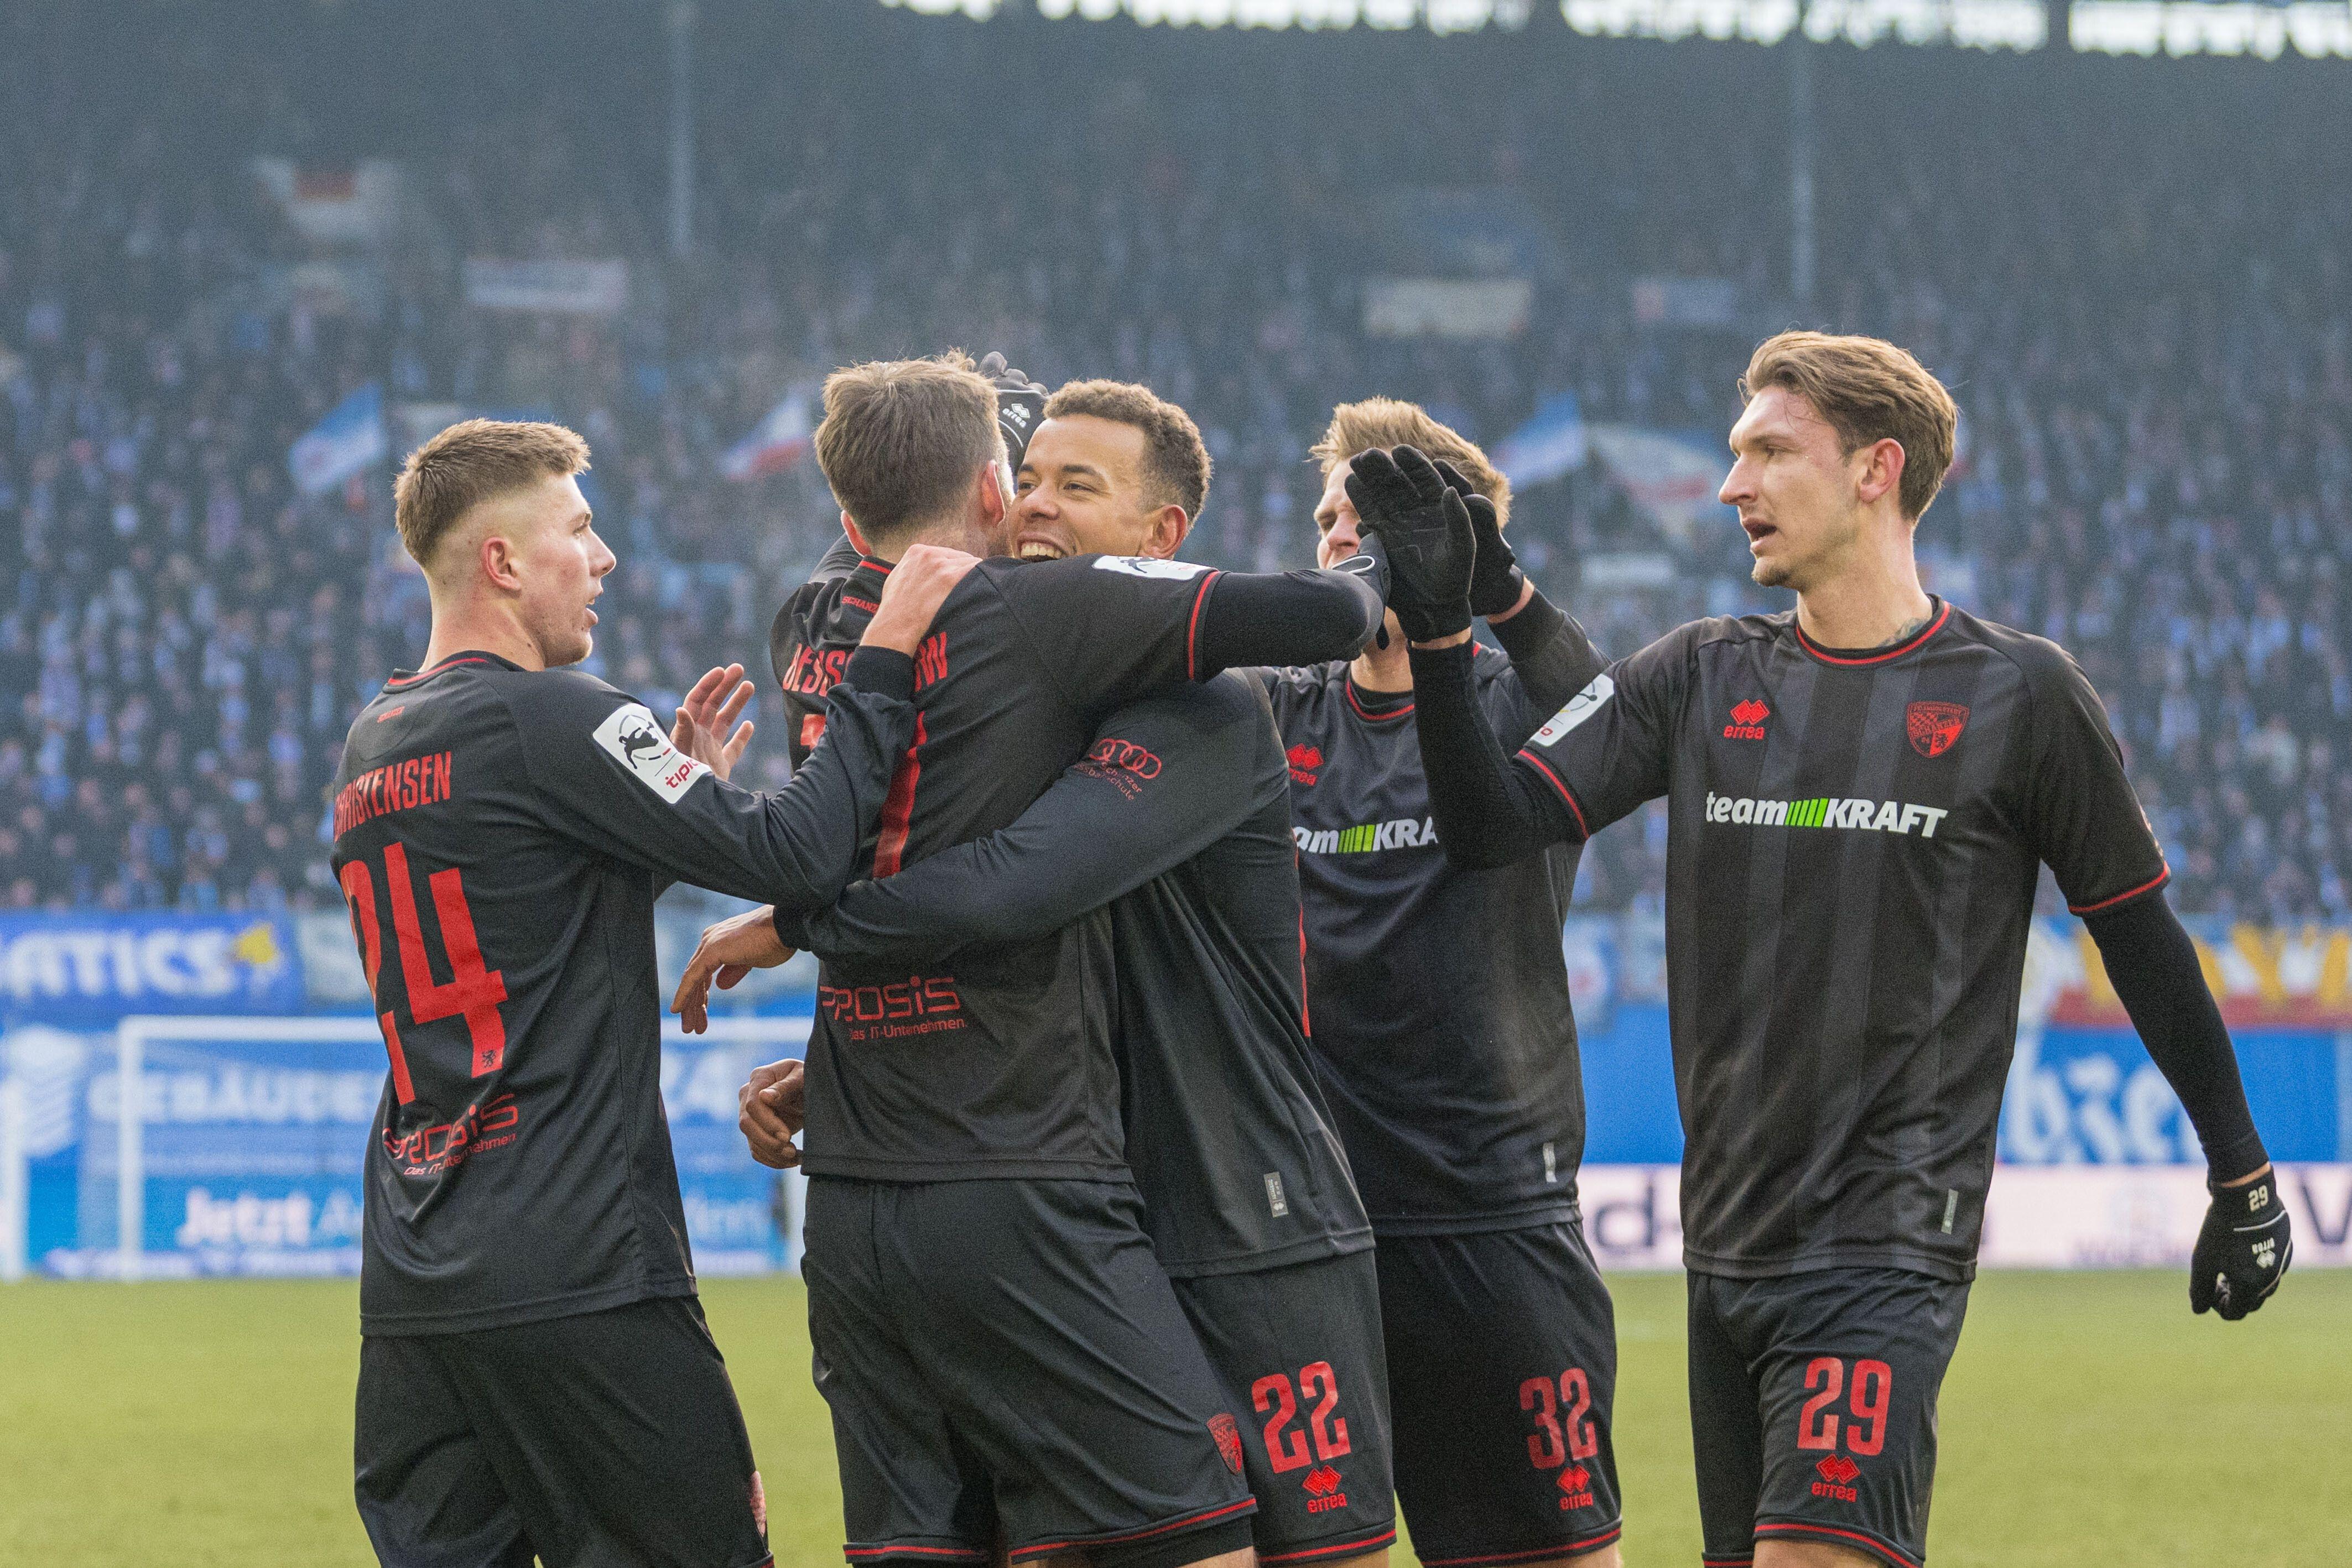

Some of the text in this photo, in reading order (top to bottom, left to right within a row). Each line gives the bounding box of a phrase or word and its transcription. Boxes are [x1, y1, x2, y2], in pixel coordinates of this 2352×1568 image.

[1002, 408, 1027, 428] errea
[1724, 725, 1765, 739] errea
[2248, 1185, 2268, 1212] 29
[1252, 1361, 1351, 1473] 22
[1520, 1368, 1598, 1470] 32
[1797, 1357, 1892, 1456] 29
[1307, 1492, 1347, 1513] errea
[1812, 1480, 1857, 1503] errea
